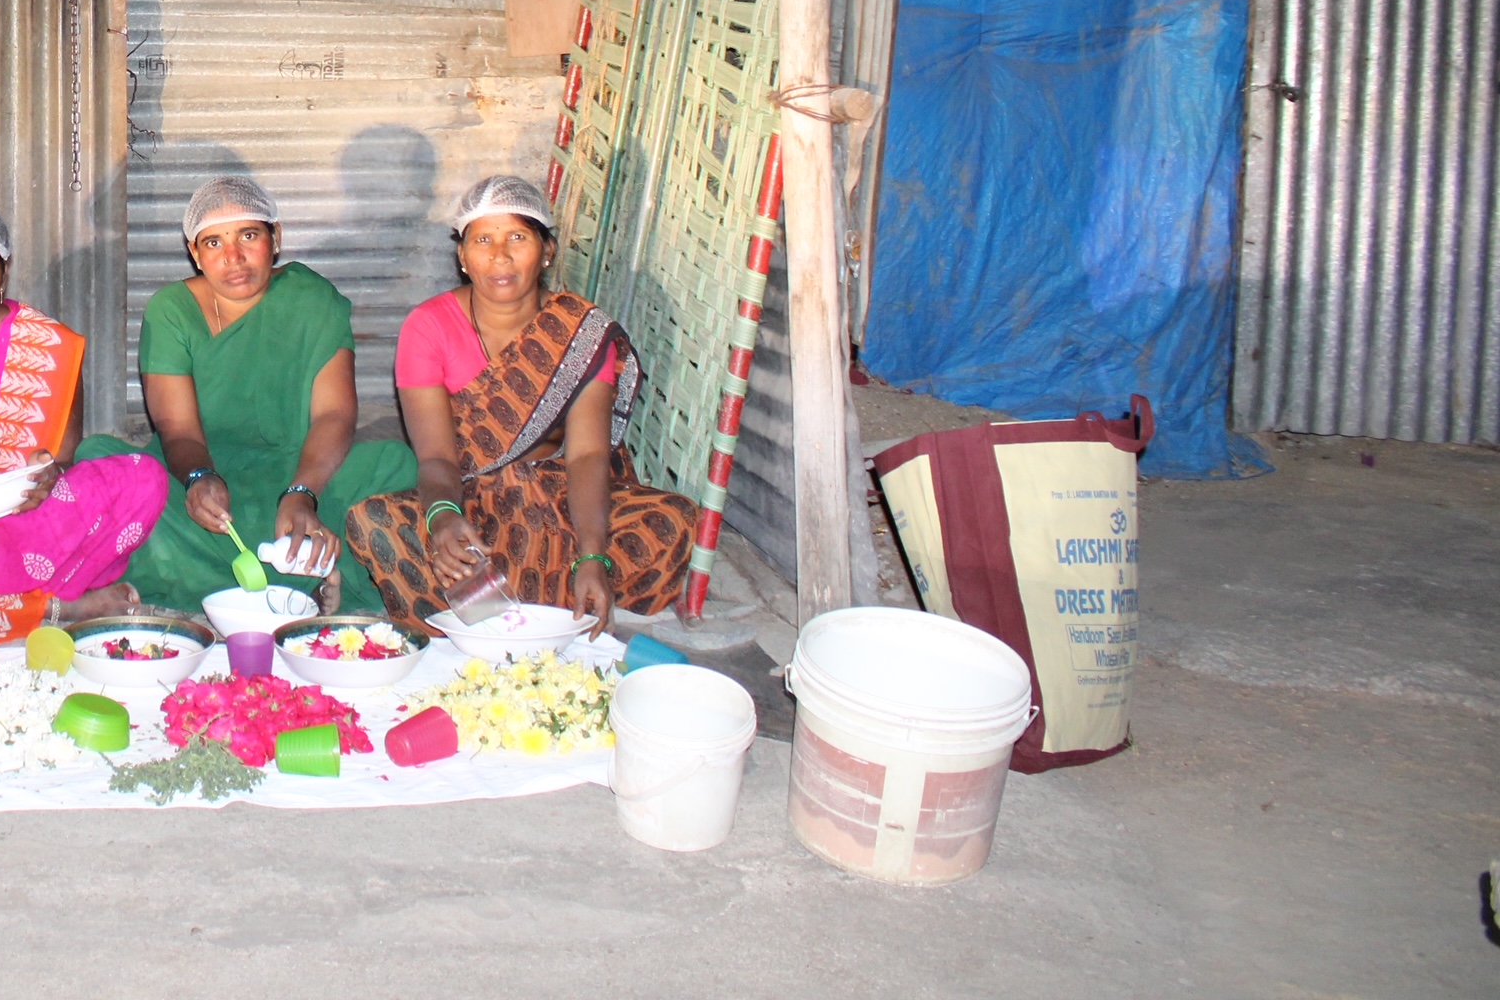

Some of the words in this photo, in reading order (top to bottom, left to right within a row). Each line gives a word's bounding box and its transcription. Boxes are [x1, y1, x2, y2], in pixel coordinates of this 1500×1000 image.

[1056, 538, 1122, 566] LAKSHMI
[1055, 588, 1105, 616] DRESS
[1069, 626, 1105, 644] Handloom
